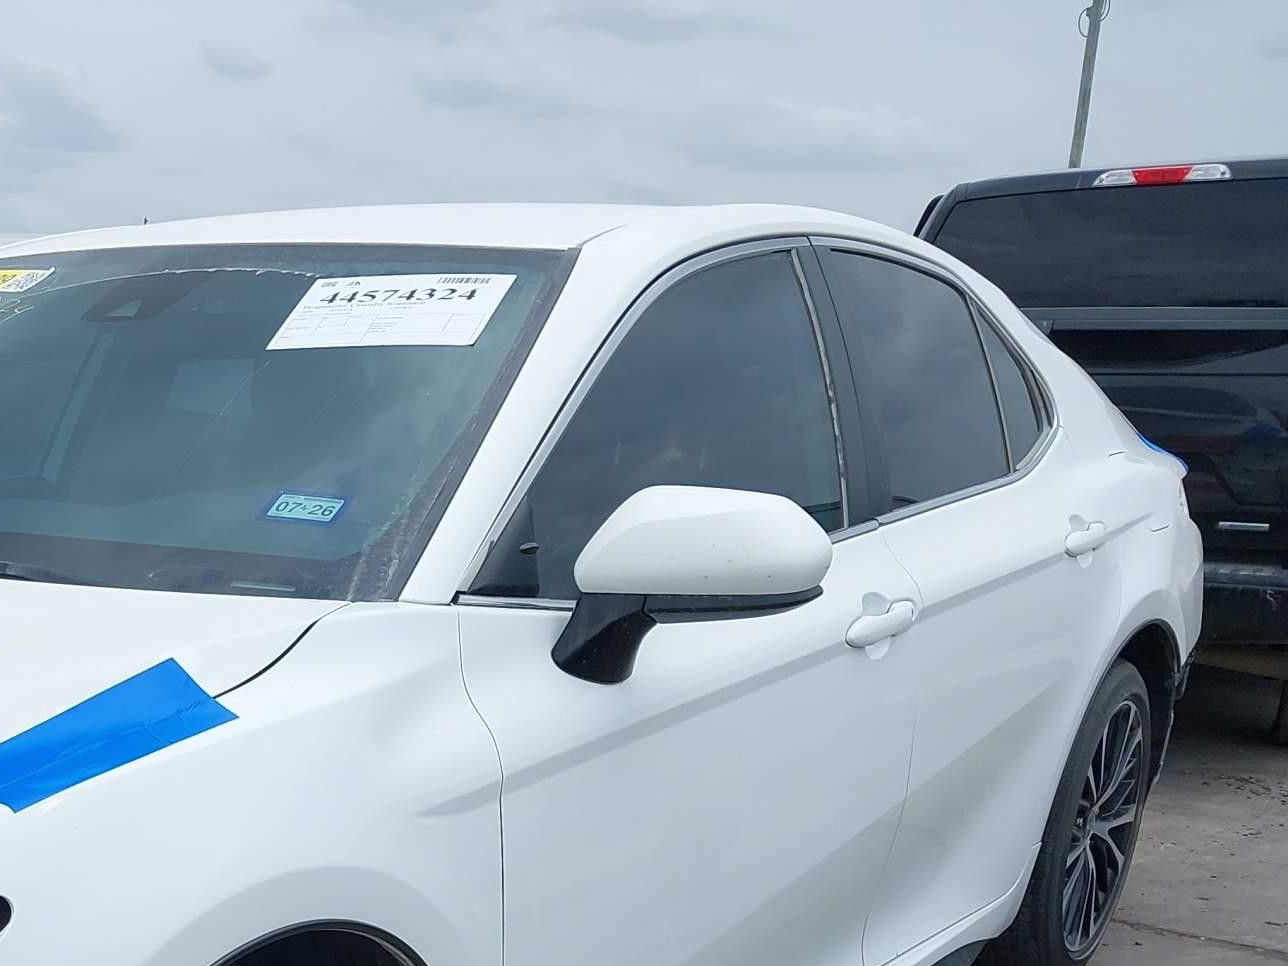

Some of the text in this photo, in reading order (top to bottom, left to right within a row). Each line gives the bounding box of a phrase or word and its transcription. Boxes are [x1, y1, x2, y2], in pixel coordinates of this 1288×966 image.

[320, 288, 478, 305] 44574324
[275, 501, 336, 517] 07 26
